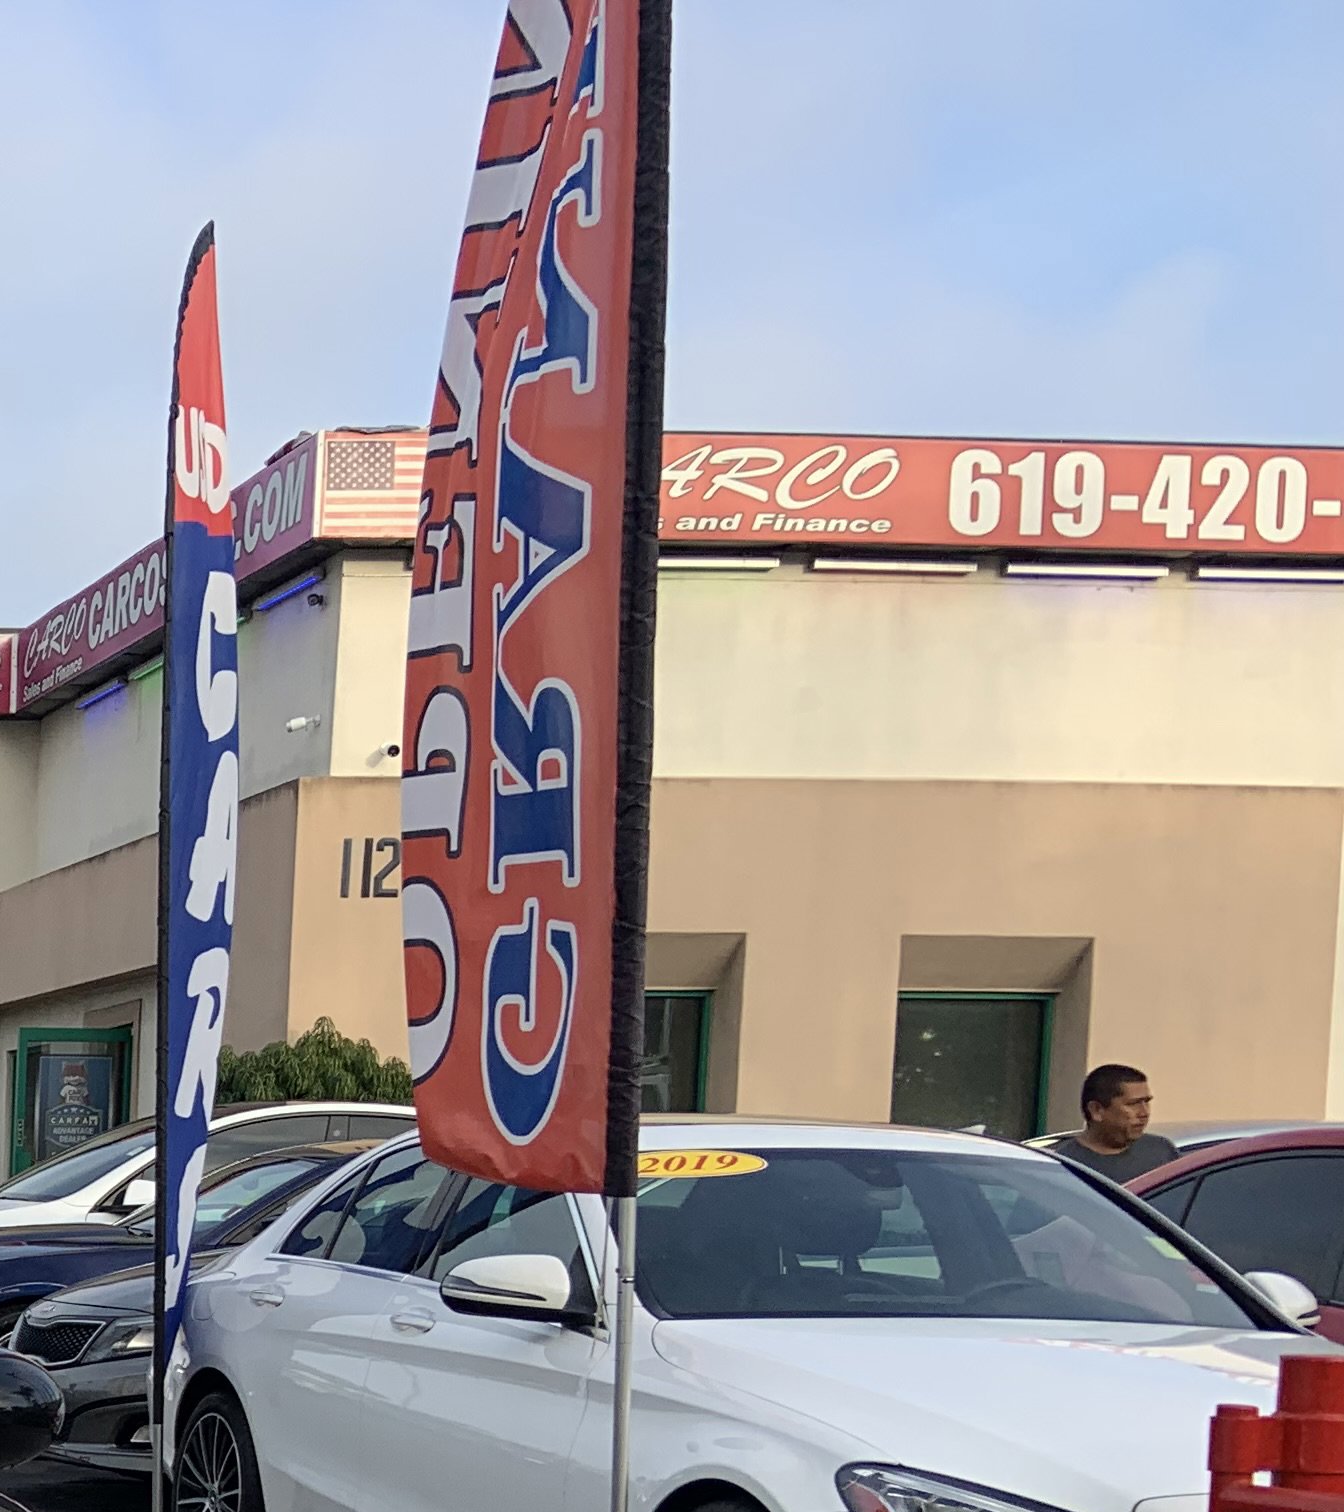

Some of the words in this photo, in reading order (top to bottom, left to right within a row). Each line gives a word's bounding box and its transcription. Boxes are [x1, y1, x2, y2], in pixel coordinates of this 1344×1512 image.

[660, 444, 901, 510] ARCO
[948, 448, 1342, 544] 619-420-
[675, 513, 743, 532] and
[751, 513, 892, 534] Finance
[24, 598, 87, 678] CARCO
[23, 682, 41, 703] Sales
[56, 657, 83, 681] Finance
[638, 1154, 739, 1174] 2019
